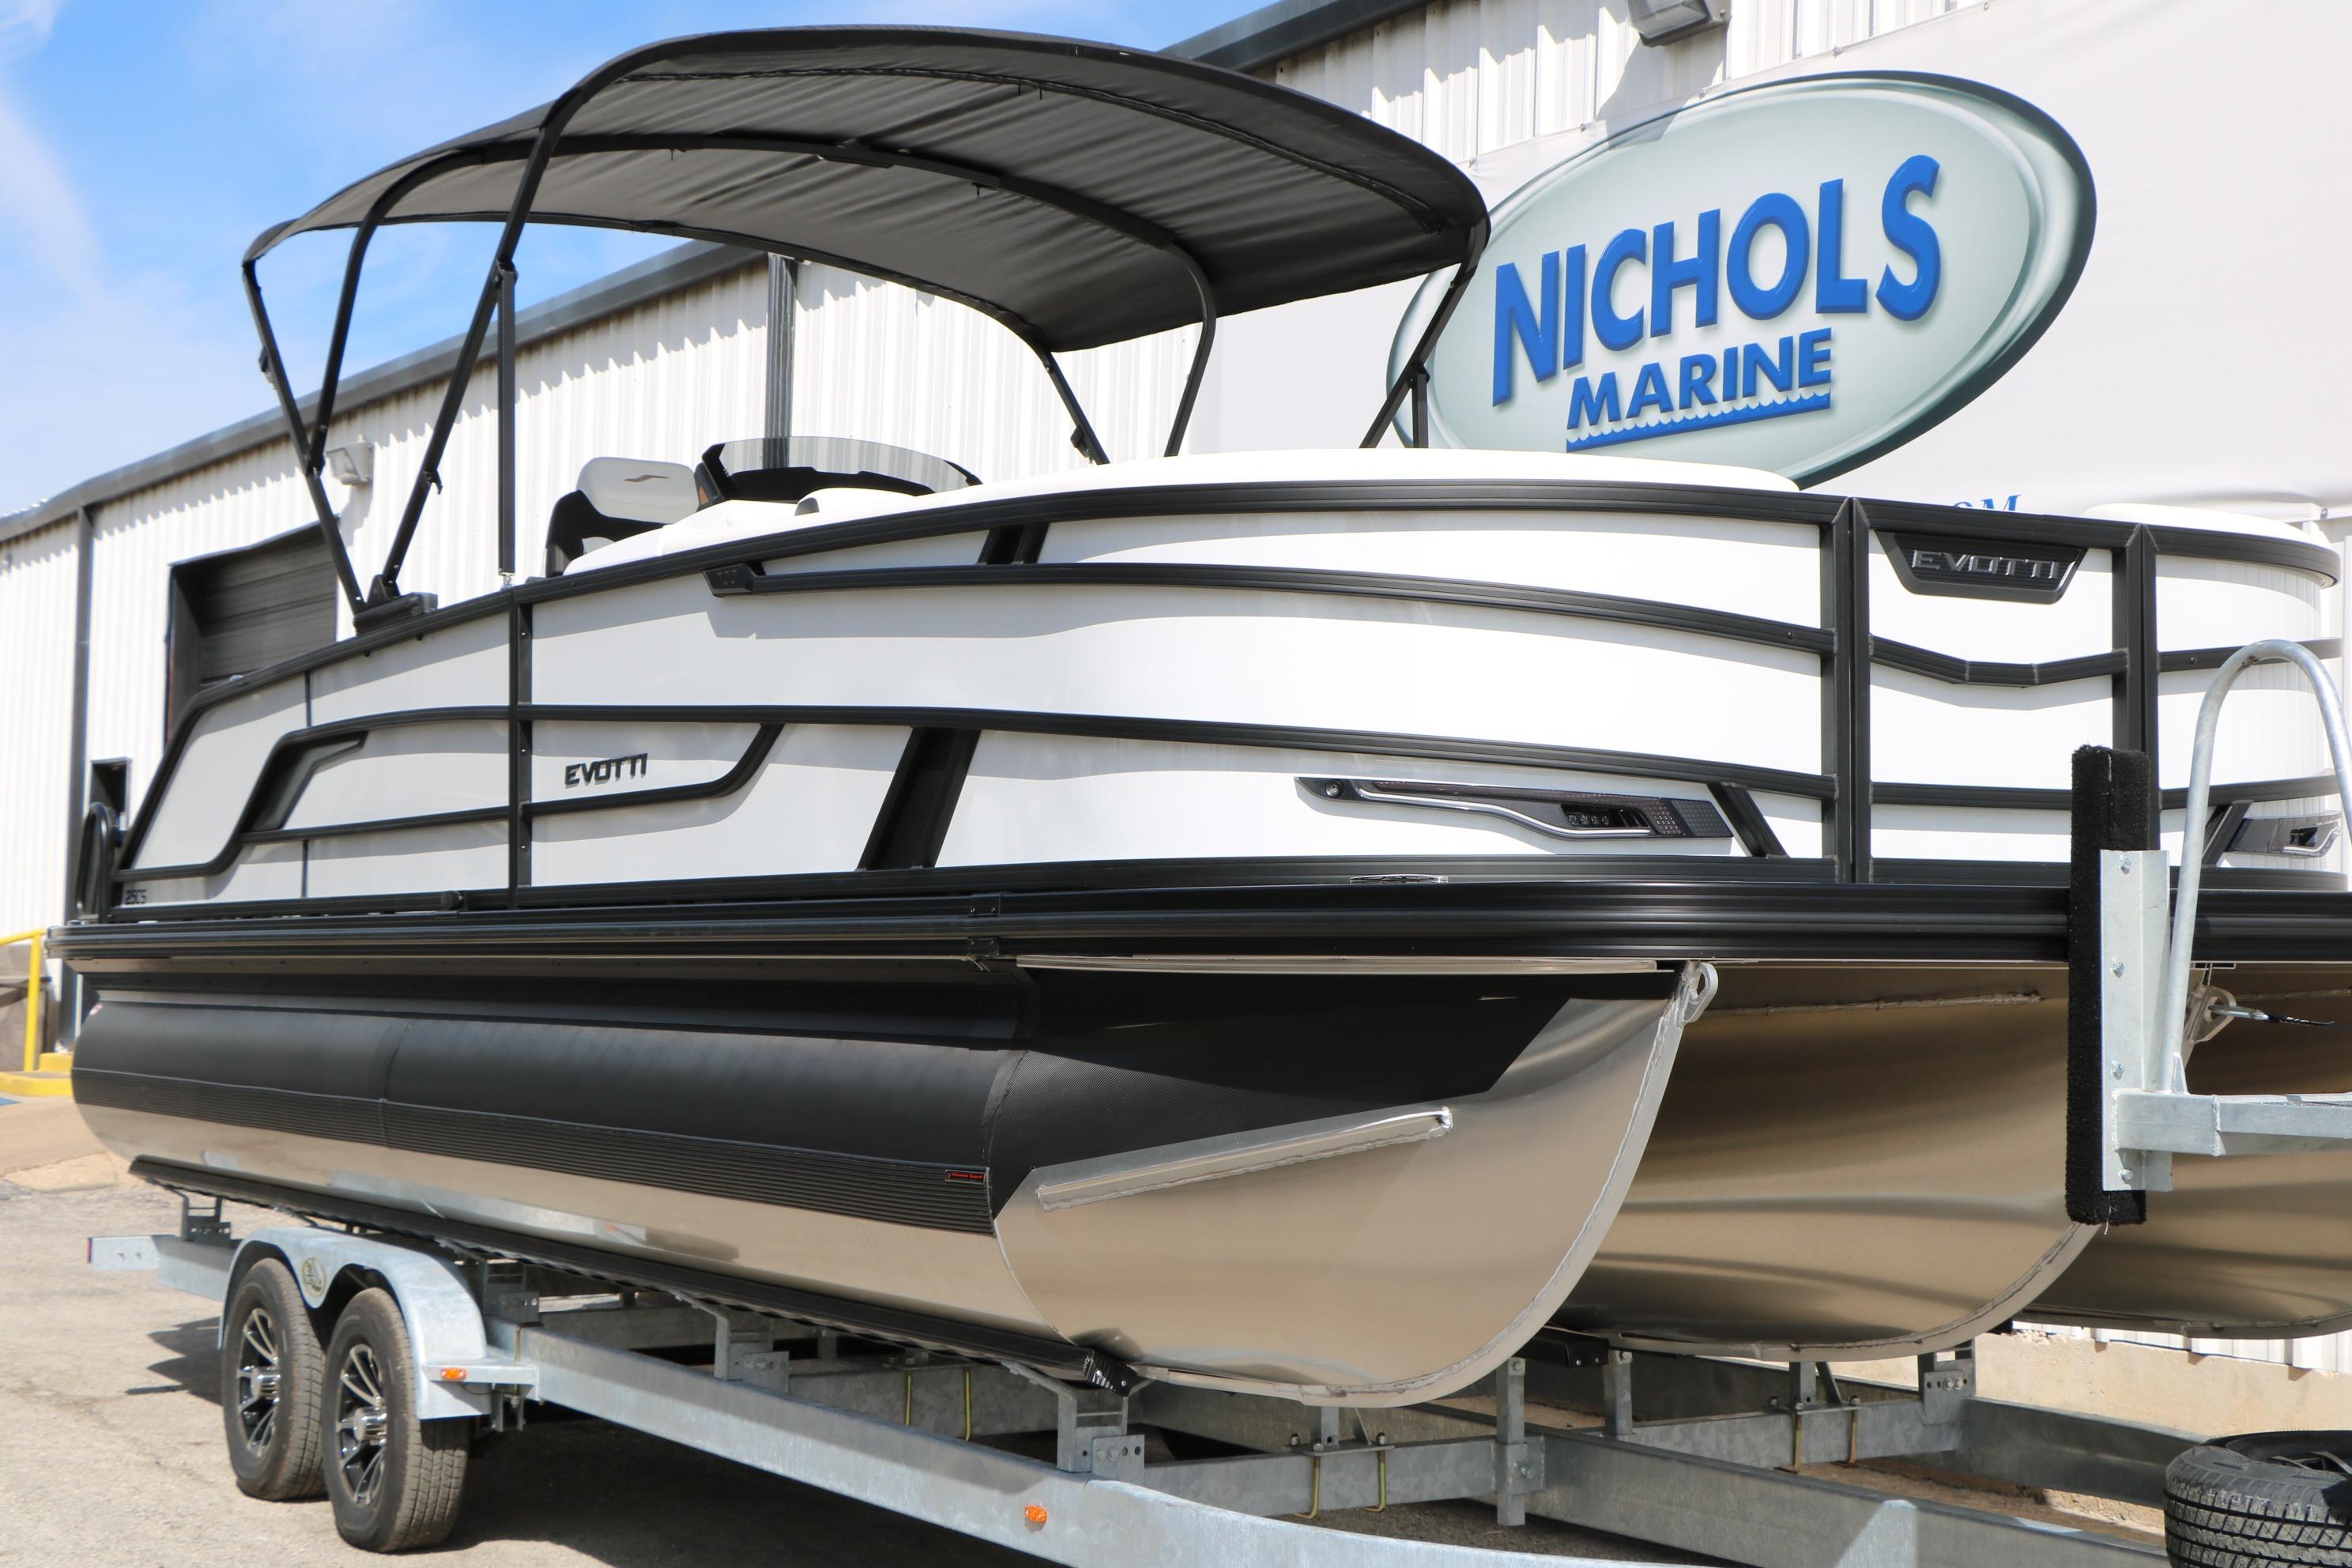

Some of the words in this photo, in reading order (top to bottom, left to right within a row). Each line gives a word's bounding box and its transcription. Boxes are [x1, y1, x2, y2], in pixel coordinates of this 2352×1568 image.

[1493, 154, 1941, 406] NICHOLS
[1567, 328, 1832, 429] MARINE
[1911, 549, 2060, 579] EVOTTI
[564, 752, 648, 786] EVOTTI
